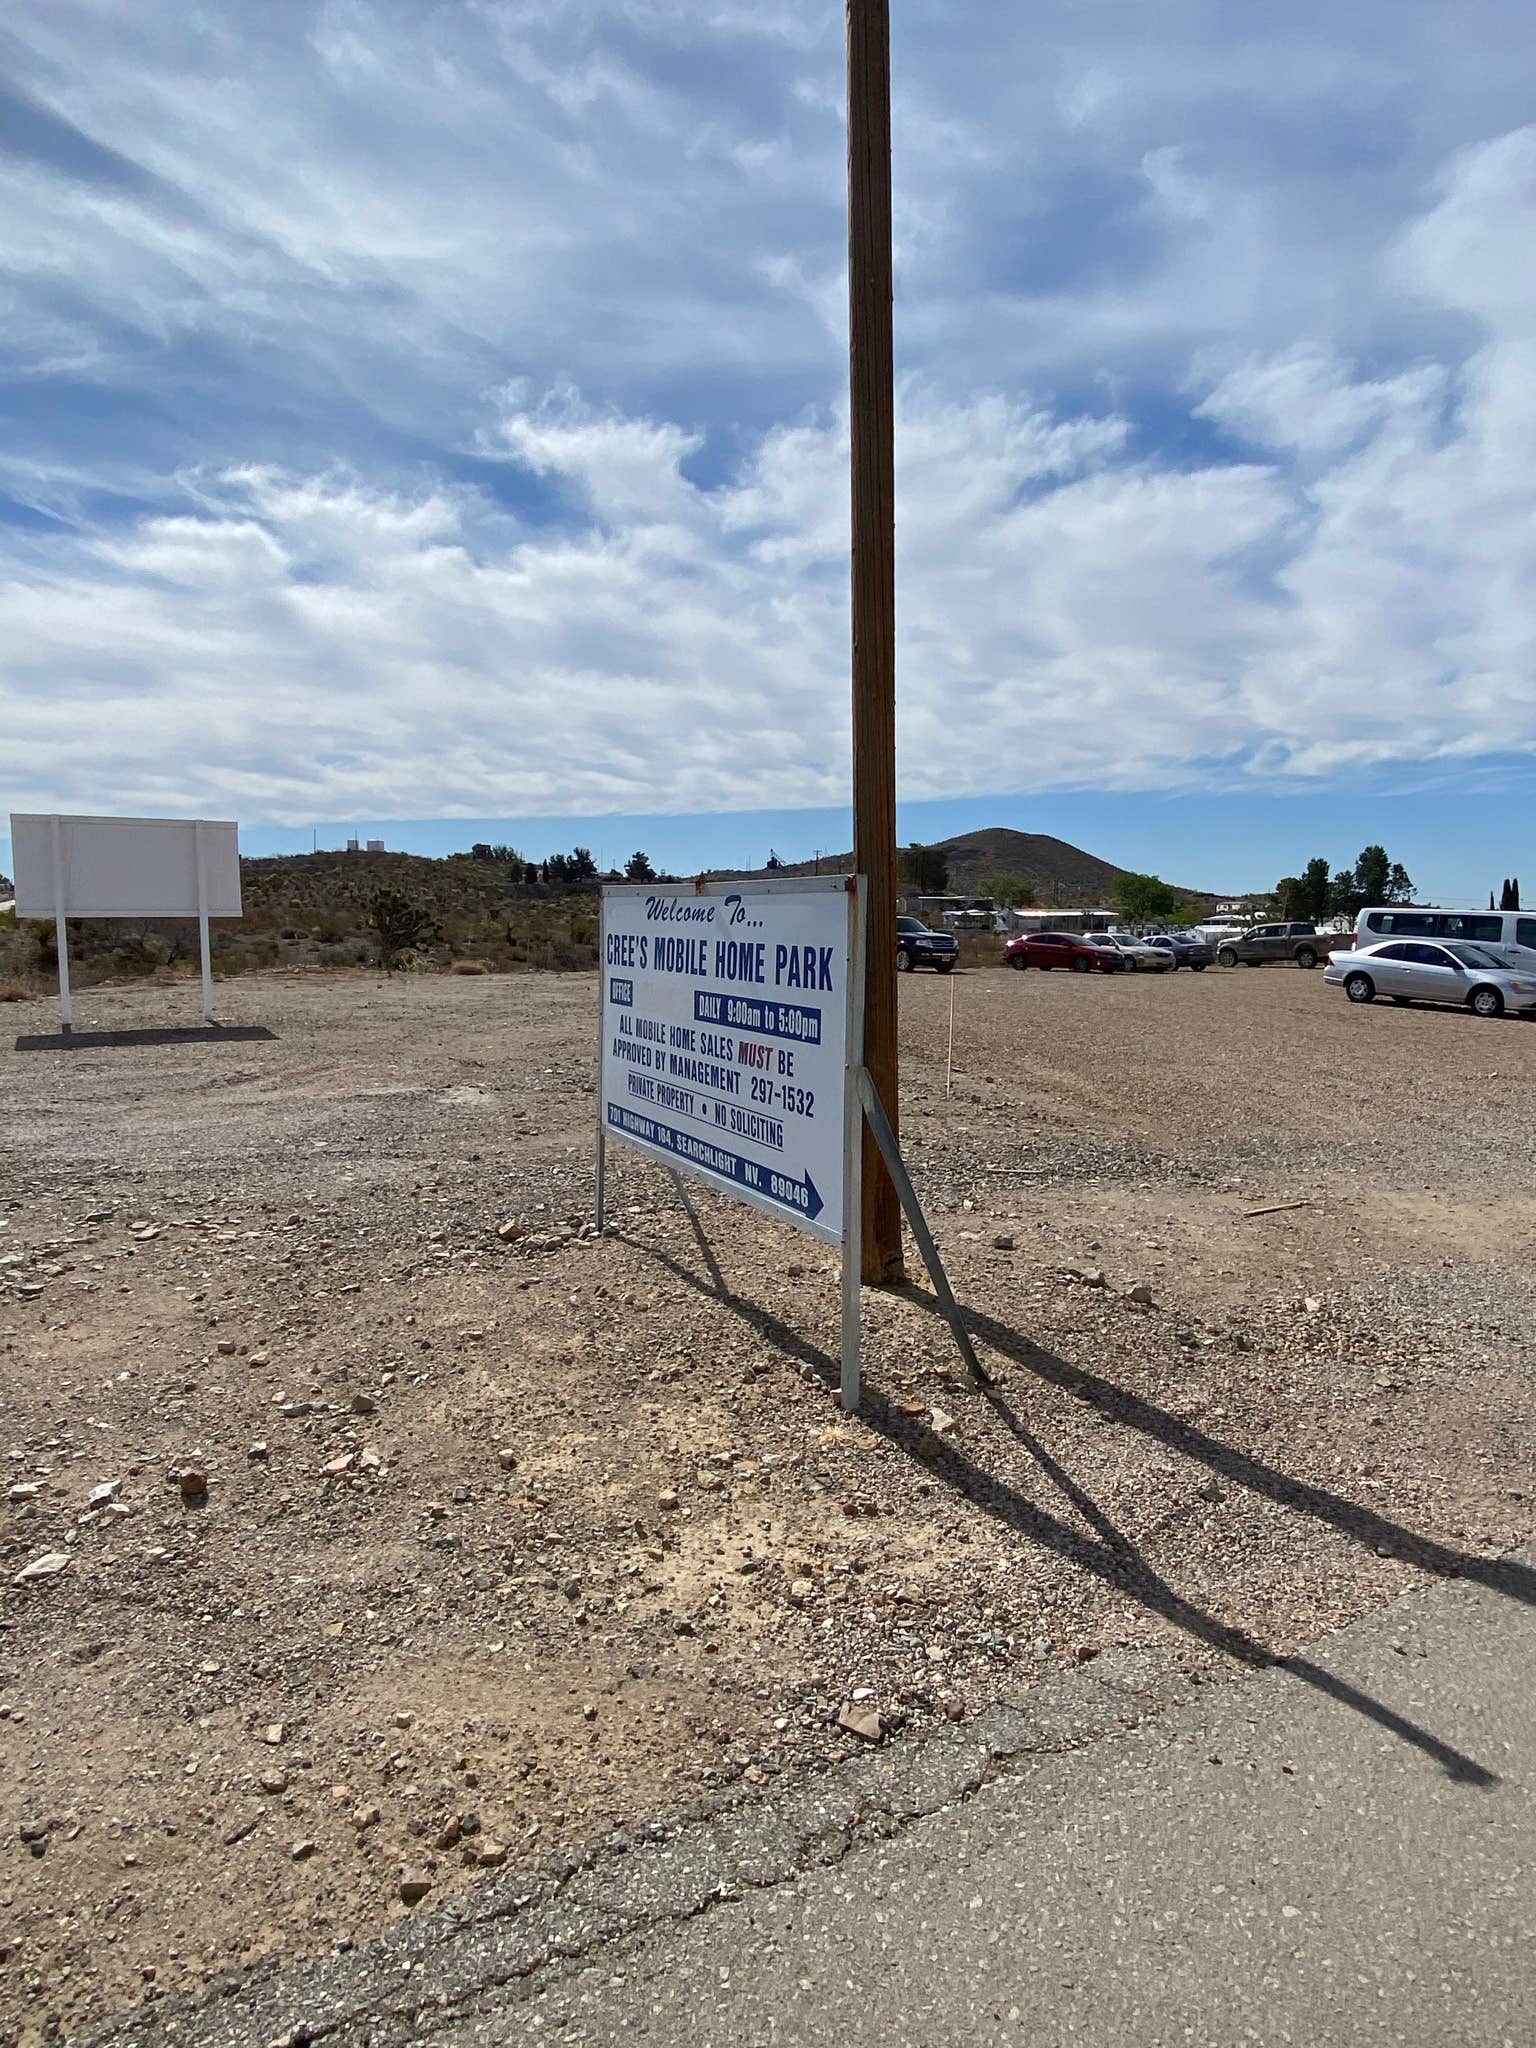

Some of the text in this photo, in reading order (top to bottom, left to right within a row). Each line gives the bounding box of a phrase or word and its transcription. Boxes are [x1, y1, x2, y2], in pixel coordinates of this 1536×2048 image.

[646, 895, 763, 927] Welcome To...
[607, 933, 834, 992] CREE'S MOBILE HOME PARK
[612, 981, 631, 1003] OFFICE
[620, 1014, 794, 1077] ALL MOBILE HOME SALES MUST BE
[699, 995, 818, 1040] DAILY 9:00am to 5:00pm
[613, 1038, 814, 1118] APPROVED BY MANAGEMENT 297-1532
[628, 1074, 783, 1148] PRIVATE PROPERTY NO SOLICITING
[622, 1111, 655, 1138] HIGHWAY
[676, 1134, 737, 1175] SEARCHLIGHT
[744, 1163, 762, 1187] NV.
[770, 1174, 809, 1208] 89046
